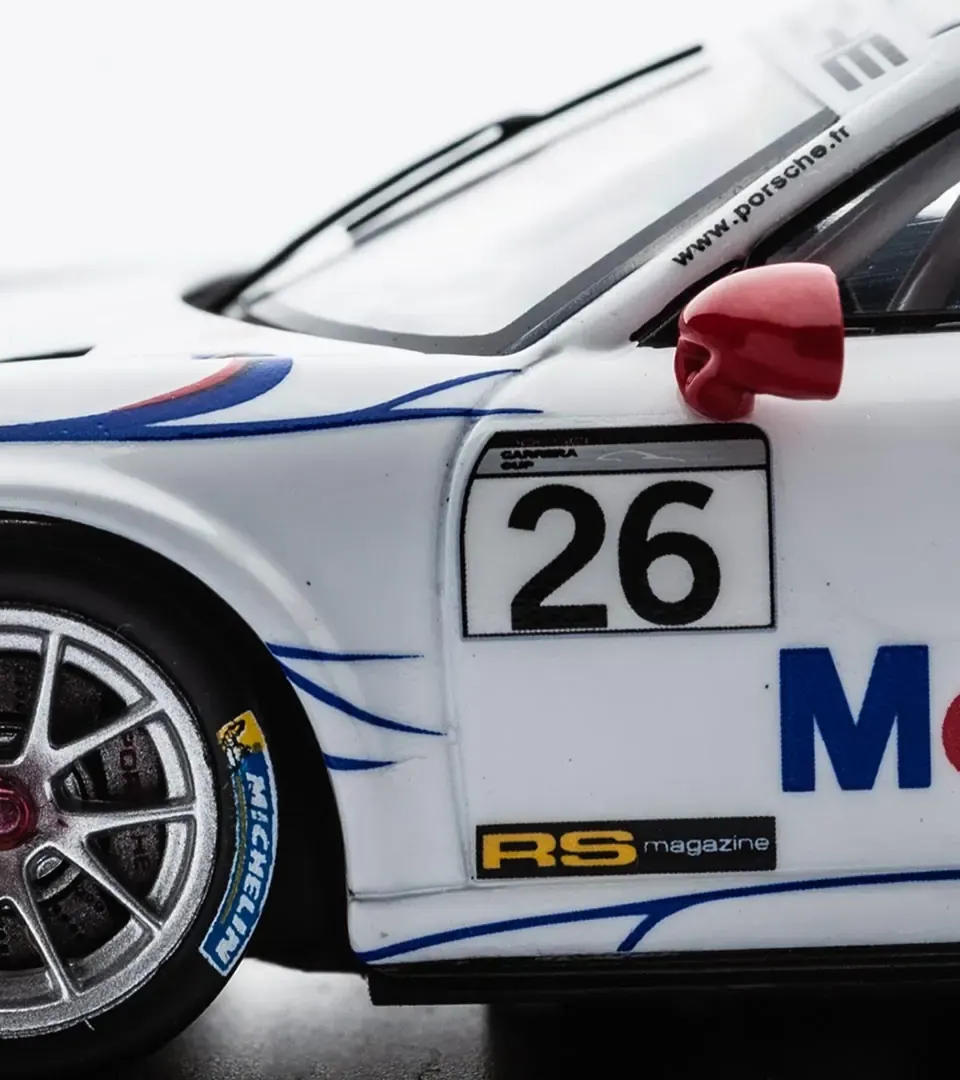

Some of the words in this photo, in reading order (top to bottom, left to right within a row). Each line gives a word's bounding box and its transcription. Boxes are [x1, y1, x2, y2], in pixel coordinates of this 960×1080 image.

[672, 125, 850, 266] www.porsche.fr
[508, 480, 721, 631] 26
[779, 644, 960, 792] M
[214, 771, 270, 966] MICHELIN
[482, 830, 638, 870] RS
[644, 834, 770, 857] magazine
